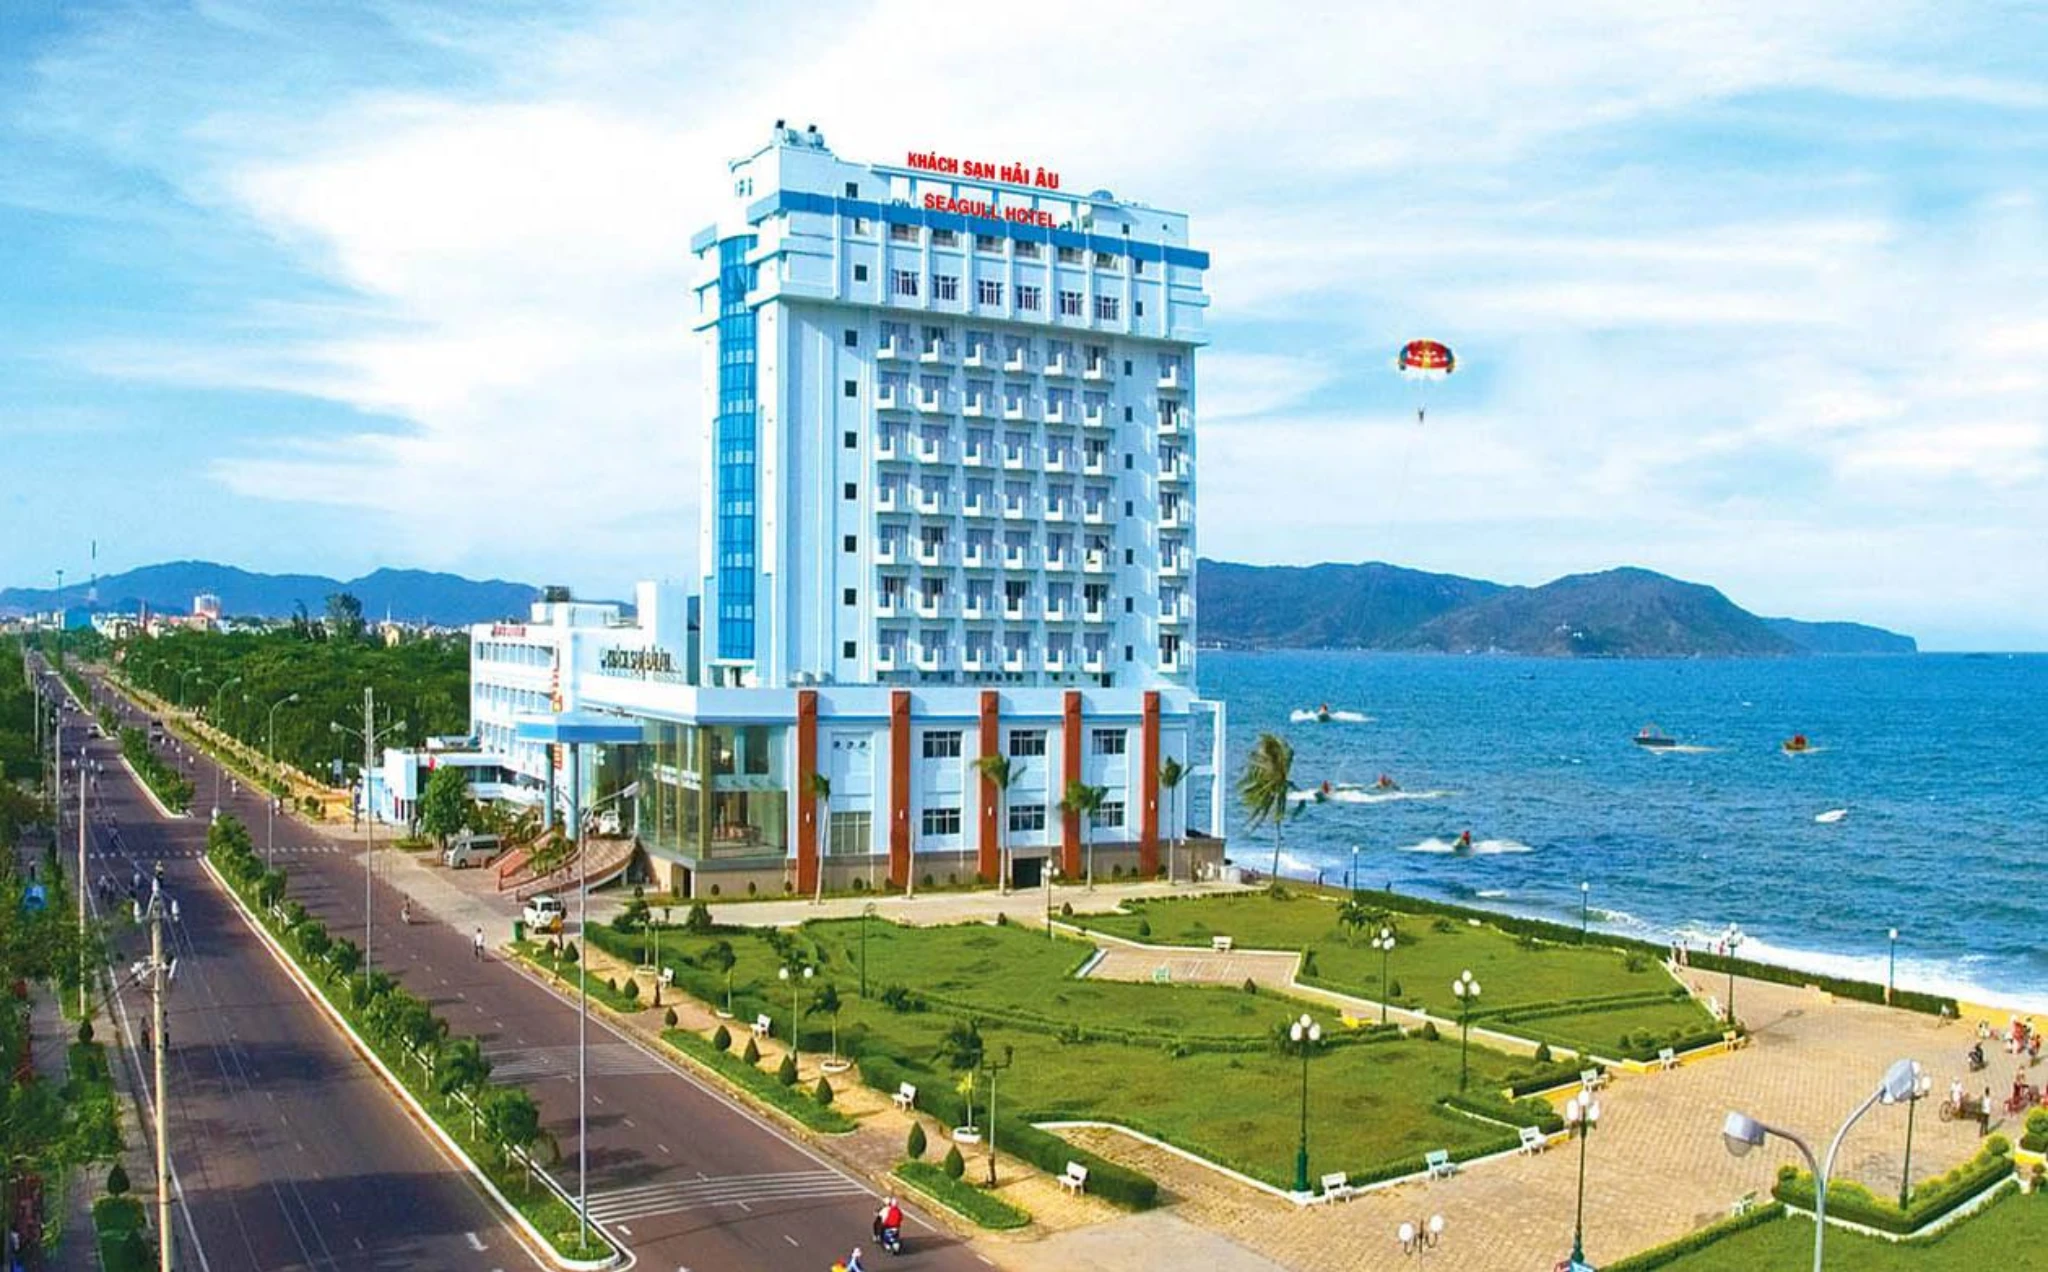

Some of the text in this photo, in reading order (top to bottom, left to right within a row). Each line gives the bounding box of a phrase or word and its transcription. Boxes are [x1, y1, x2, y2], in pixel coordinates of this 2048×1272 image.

[908, 151, 1059, 189] KHÁCH SẠN HẢI ÂU
[924, 193, 1057, 228] SEAGULL HOTEL
